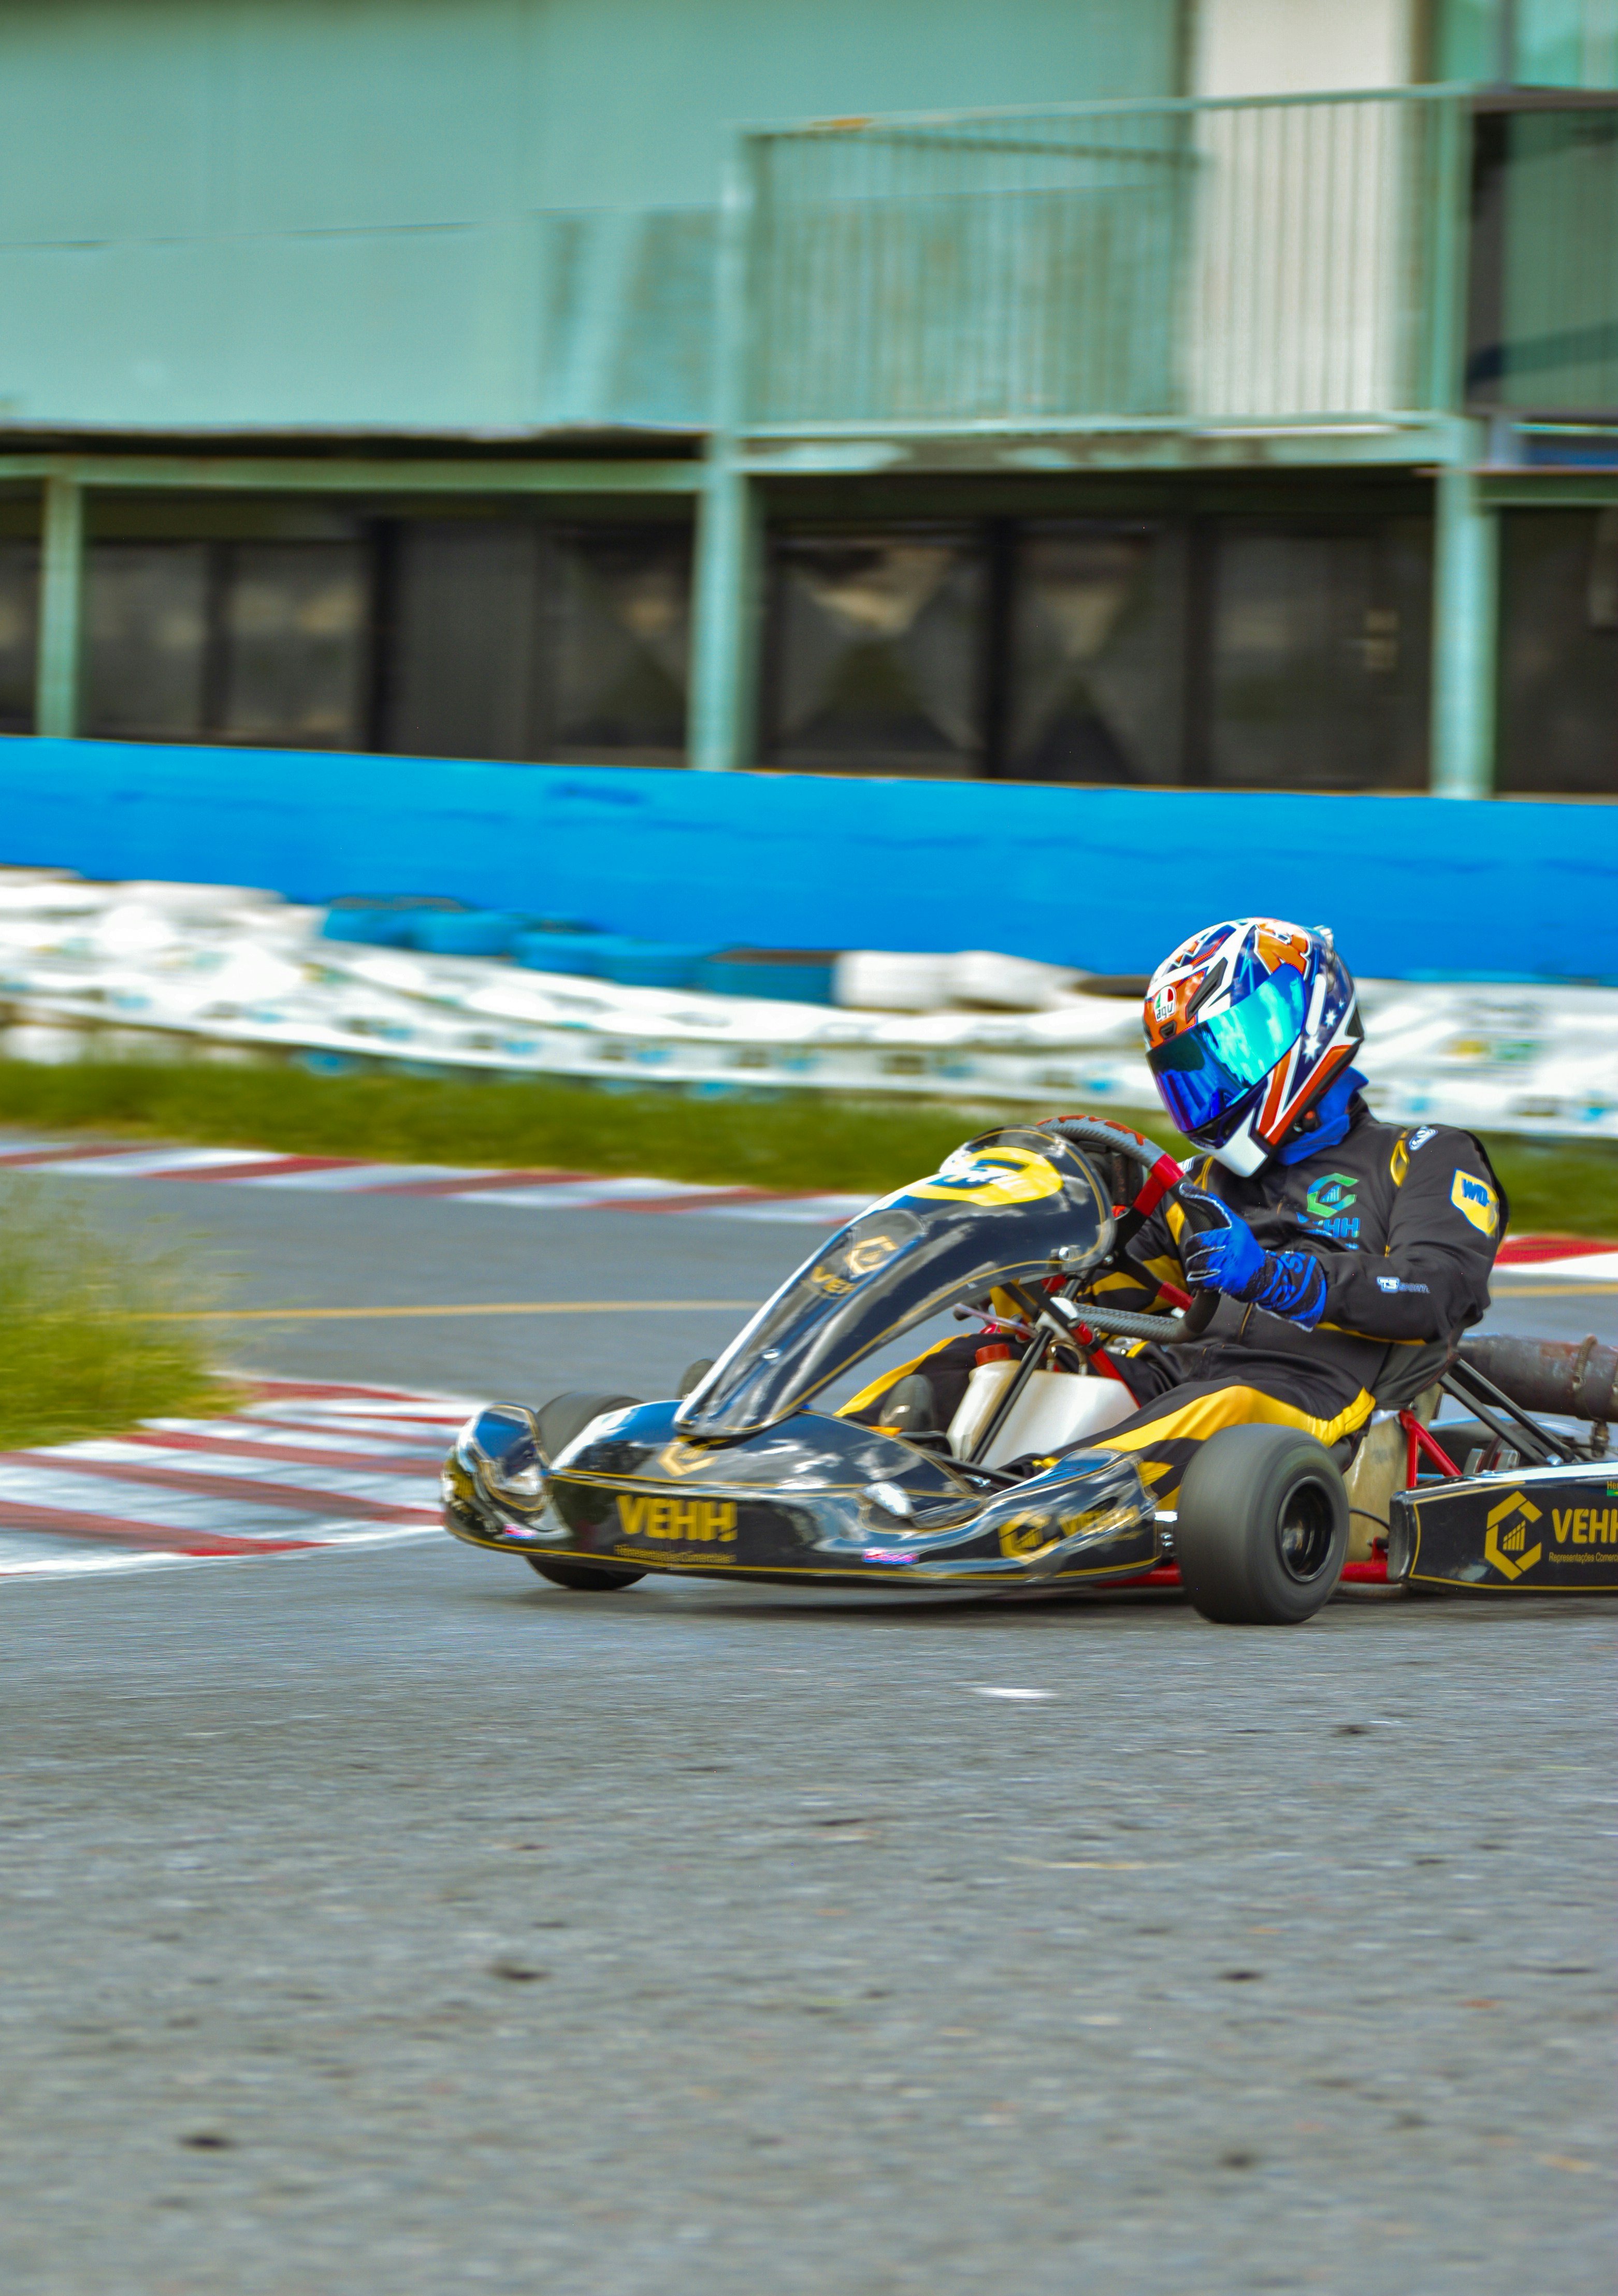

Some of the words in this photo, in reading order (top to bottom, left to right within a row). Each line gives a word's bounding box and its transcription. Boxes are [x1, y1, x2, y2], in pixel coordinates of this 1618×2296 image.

[1378, 1278, 1398, 1290] TS
[1607, 1481, 1618, 1489] He
[616, 1494, 738, 1542] VEHH
[1595, 1552, 1618, 1562] Comerc
